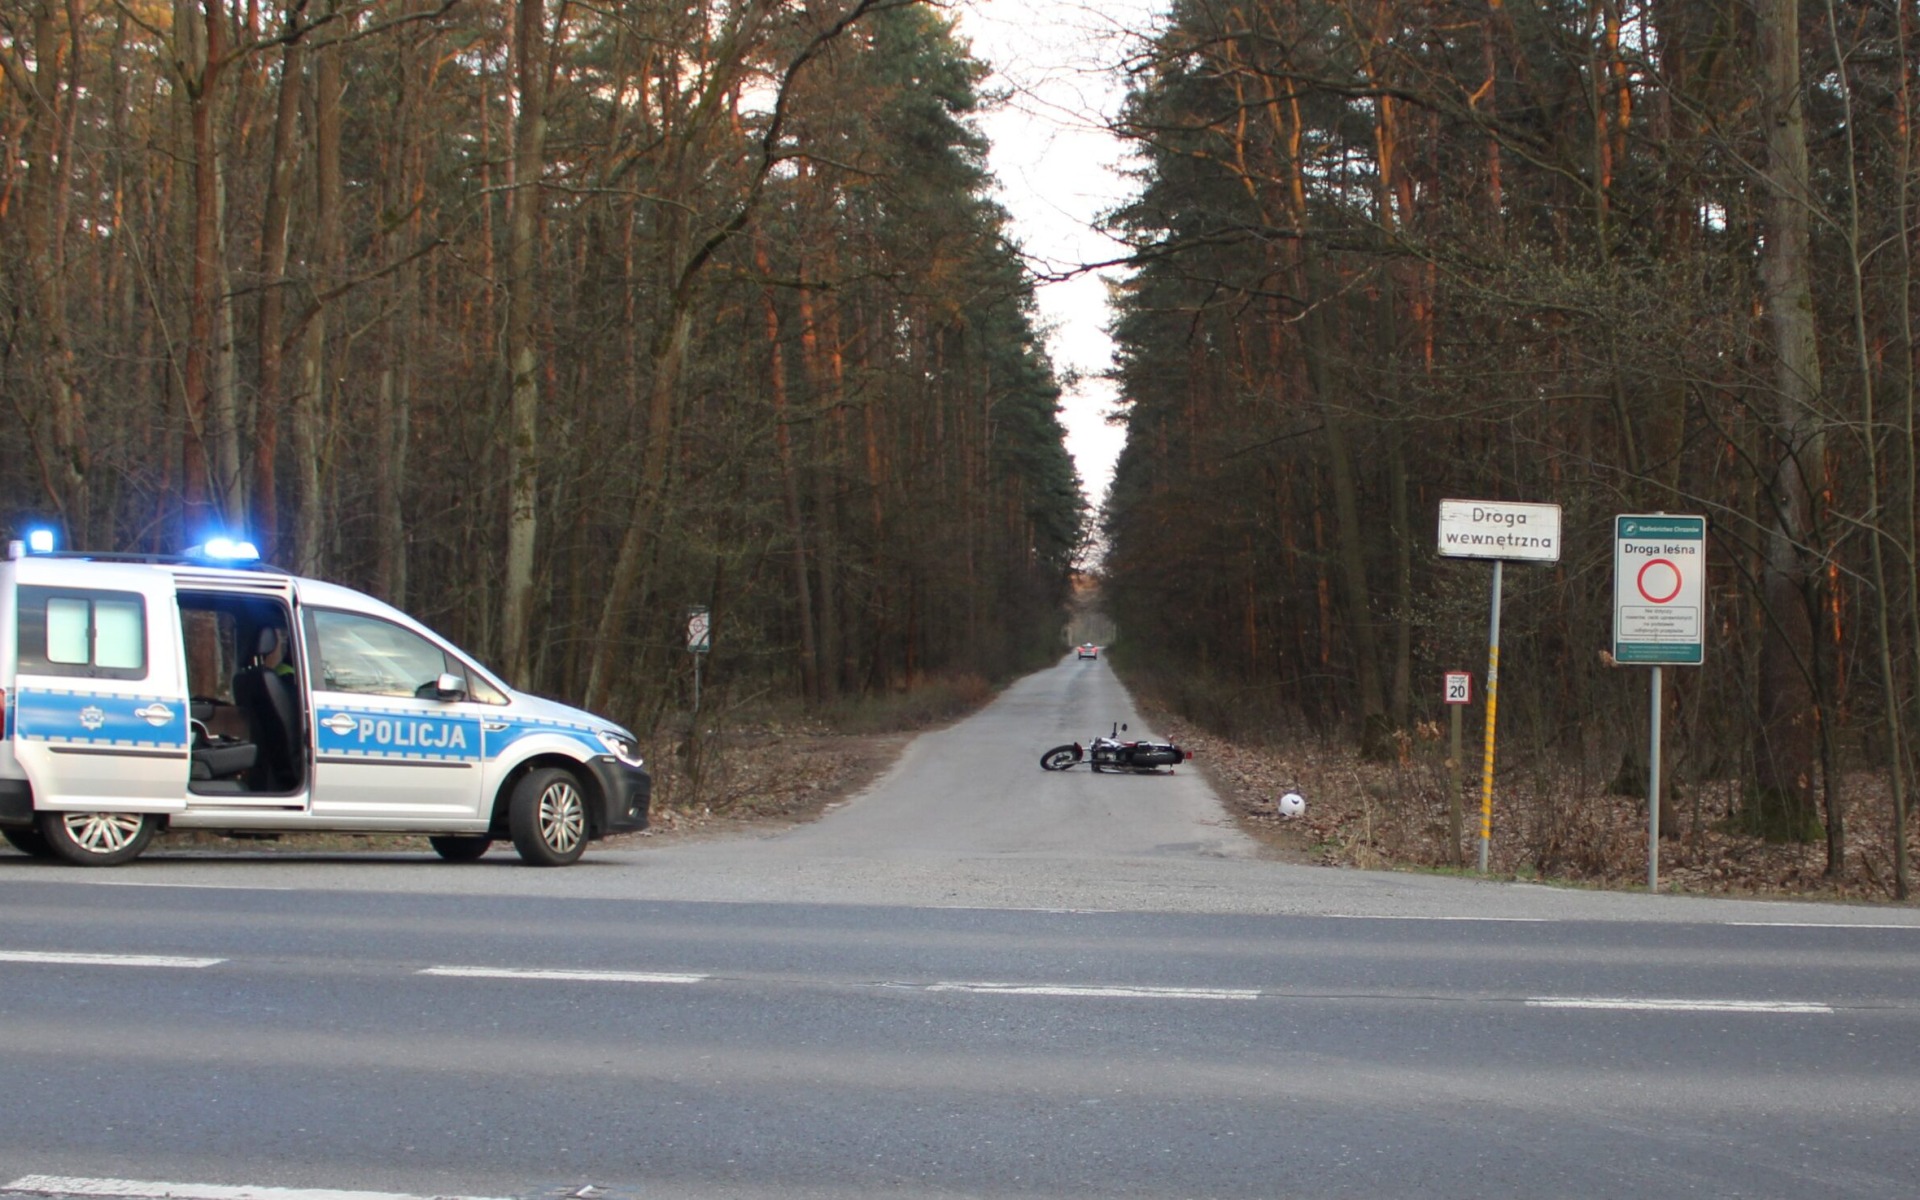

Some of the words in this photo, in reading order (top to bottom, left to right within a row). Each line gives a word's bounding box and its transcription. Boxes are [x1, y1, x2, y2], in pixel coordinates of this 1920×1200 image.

[1473, 507, 1527, 528] Droga
[1446, 532, 1552, 549] wewnętrzna
[1625, 543, 1660, 556] Droga
[1664, 544, 1695, 554] leśna
[1450, 685, 1466, 698] 20
[358, 719, 467, 749] POLICJA
